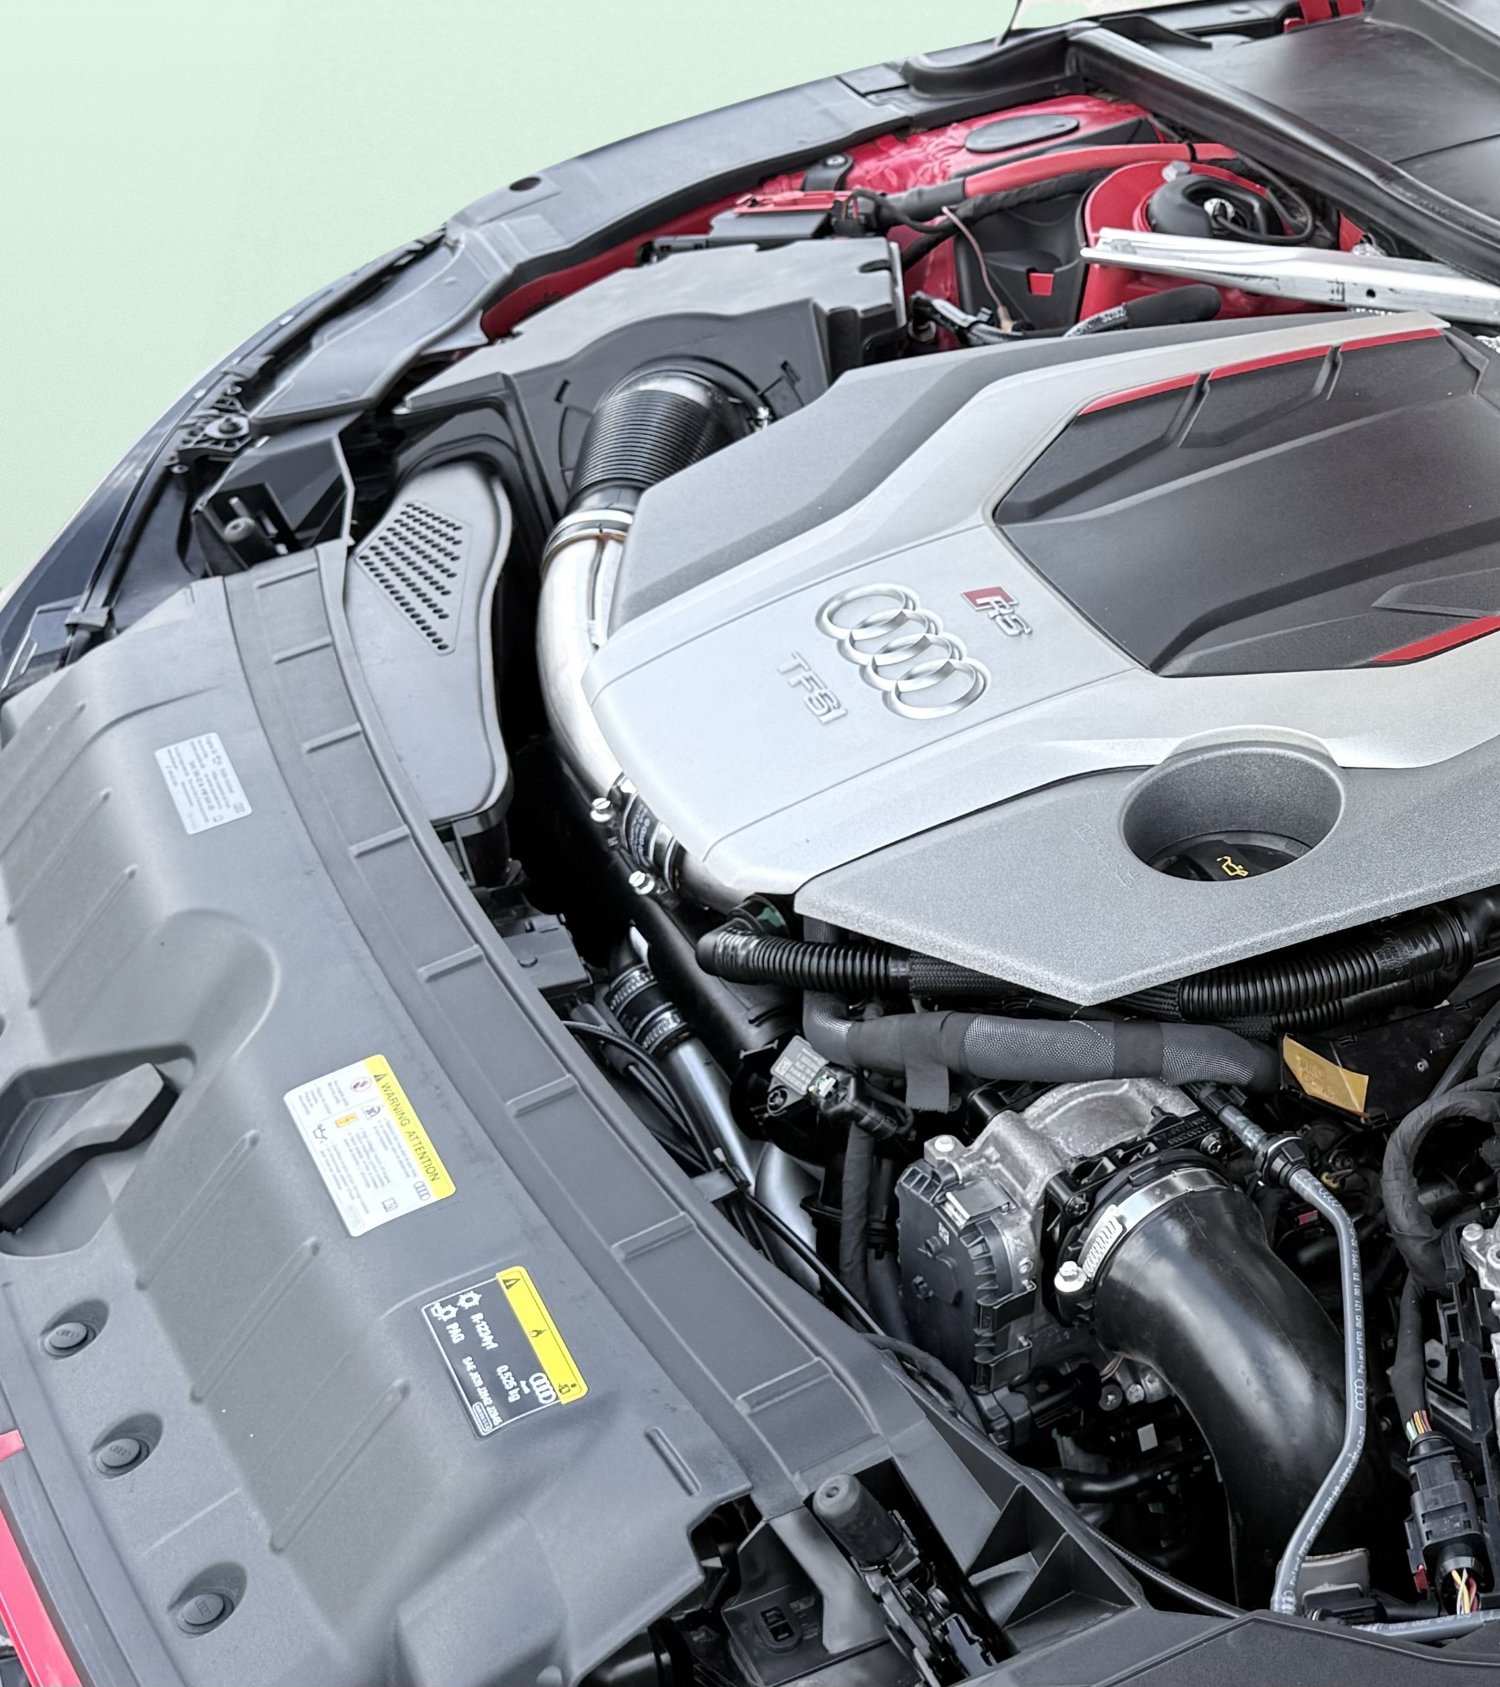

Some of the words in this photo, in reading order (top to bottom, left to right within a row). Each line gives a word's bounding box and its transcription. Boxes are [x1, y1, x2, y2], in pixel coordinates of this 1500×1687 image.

[962, 587, 1033, 637] RS
[777, 650, 848, 727] TFSI
[381, 1082, 411, 1127] WARNING
[406, 1130, 441, 1182] ATTENTION
[446, 1322, 465, 1344] PAG
[462, 1356, 476, 1371] SAE
[470, 1312, 498, 1350] R-1234yf
[508, 1387, 521, 1403] kg
